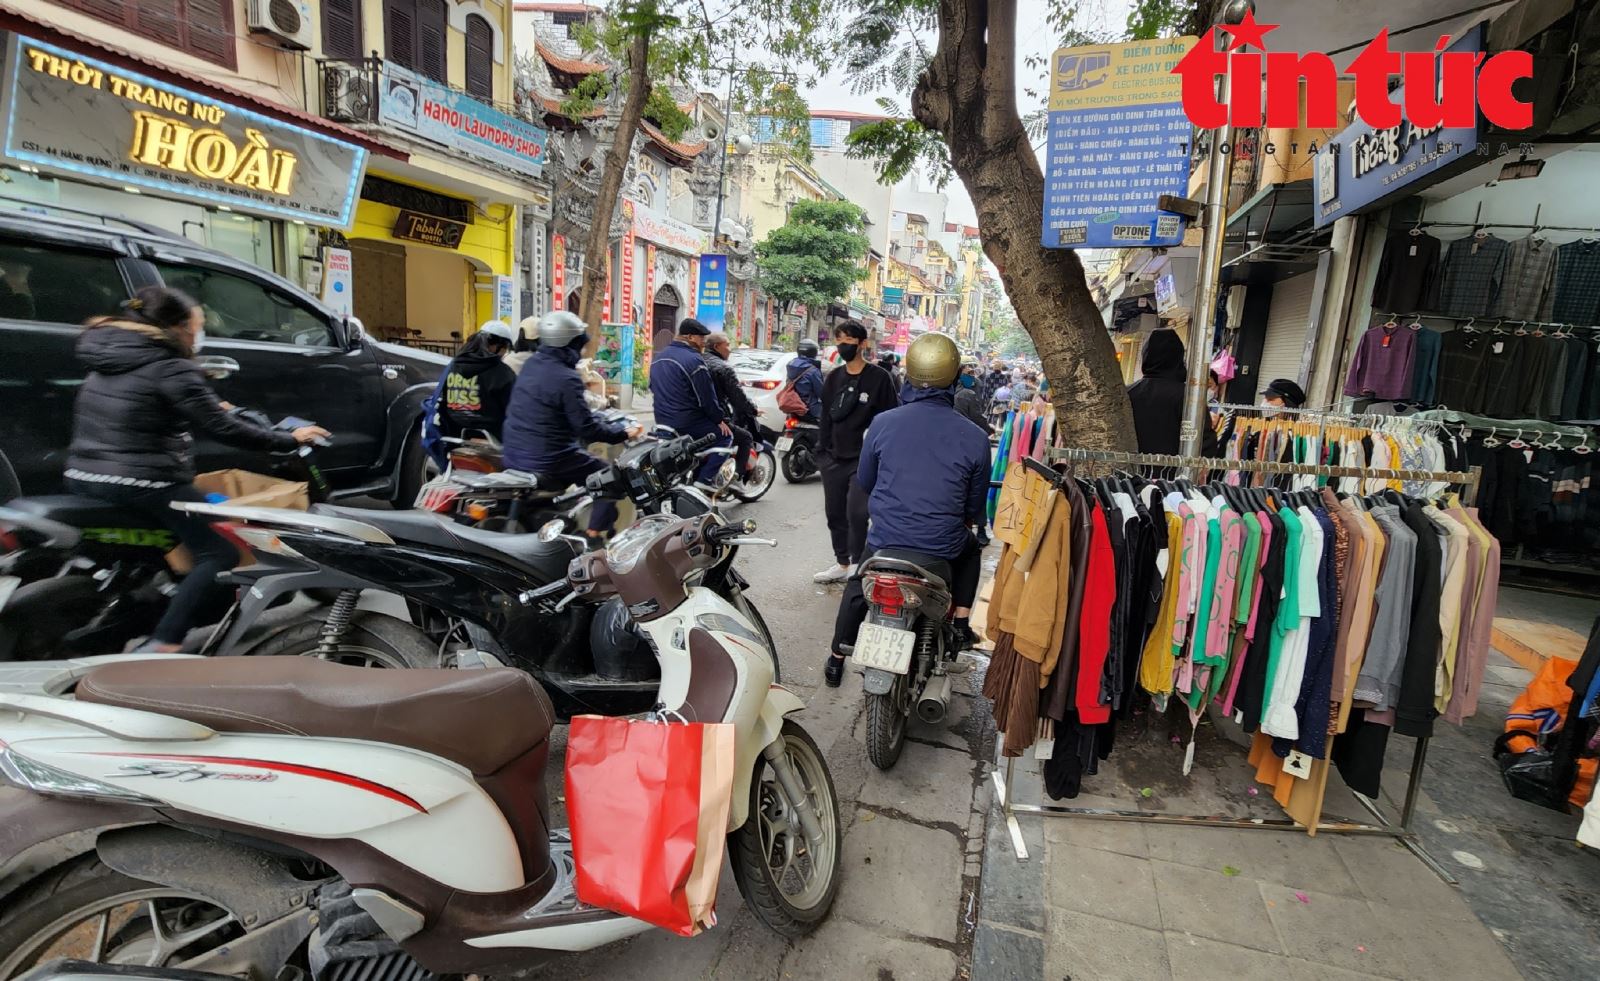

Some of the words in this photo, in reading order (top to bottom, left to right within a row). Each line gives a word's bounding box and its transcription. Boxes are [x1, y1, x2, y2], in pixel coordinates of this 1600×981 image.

[1116, 65, 1130, 76] XE
[1133, 62, 1161, 76] CHẠY
[29, 48, 103, 89] THỜI
[109, 76, 188, 115] TRANG
[192, 104, 226, 125] NỮ
[1113, 78, 1148, 90] ELECTRIC
[1149, 77, 1165, 87] BUS
[1166, 75, 1181, 86] ROU
[1085, 92, 1125, 105] TRƯỜNG
[1127, 91, 1159, 101] TRONG
[1161, 90, 1180, 101] SẠC
[1072, 113, 1082, 124] XE
[132, 109, 298, 196] HOÀI
[516, 136, 541, 158] SHOP
[409, 215, 444, 237] Tabalo
[1113, 226, 1150, 236] OPTONE
